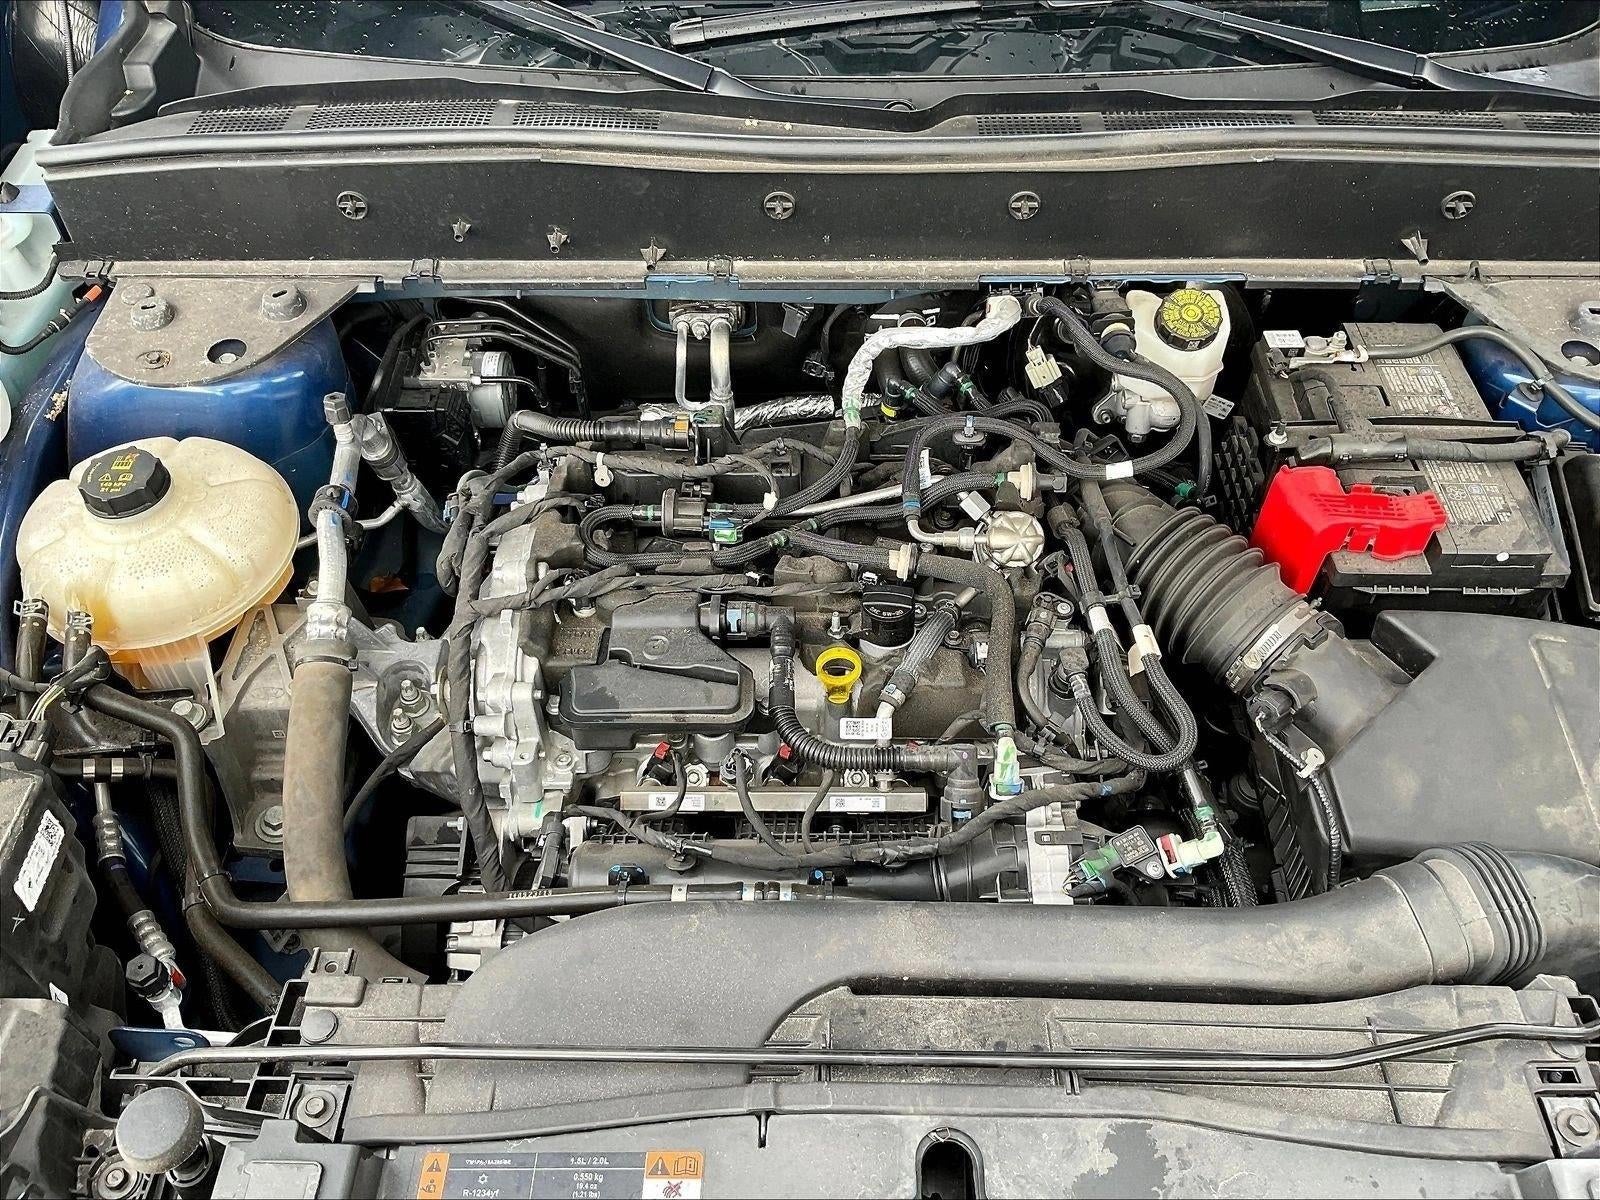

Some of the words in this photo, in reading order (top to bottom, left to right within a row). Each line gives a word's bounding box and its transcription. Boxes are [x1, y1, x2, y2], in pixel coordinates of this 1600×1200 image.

[592, 1156, 609, 1165] 2.0L
[573, 1172, 593, 1181] 0.550
[594, 1172, 604, 1183] kg
[576, 1182, 589, 1190] 19.4
[462, 1188, 500, 1199] R-1234yf
